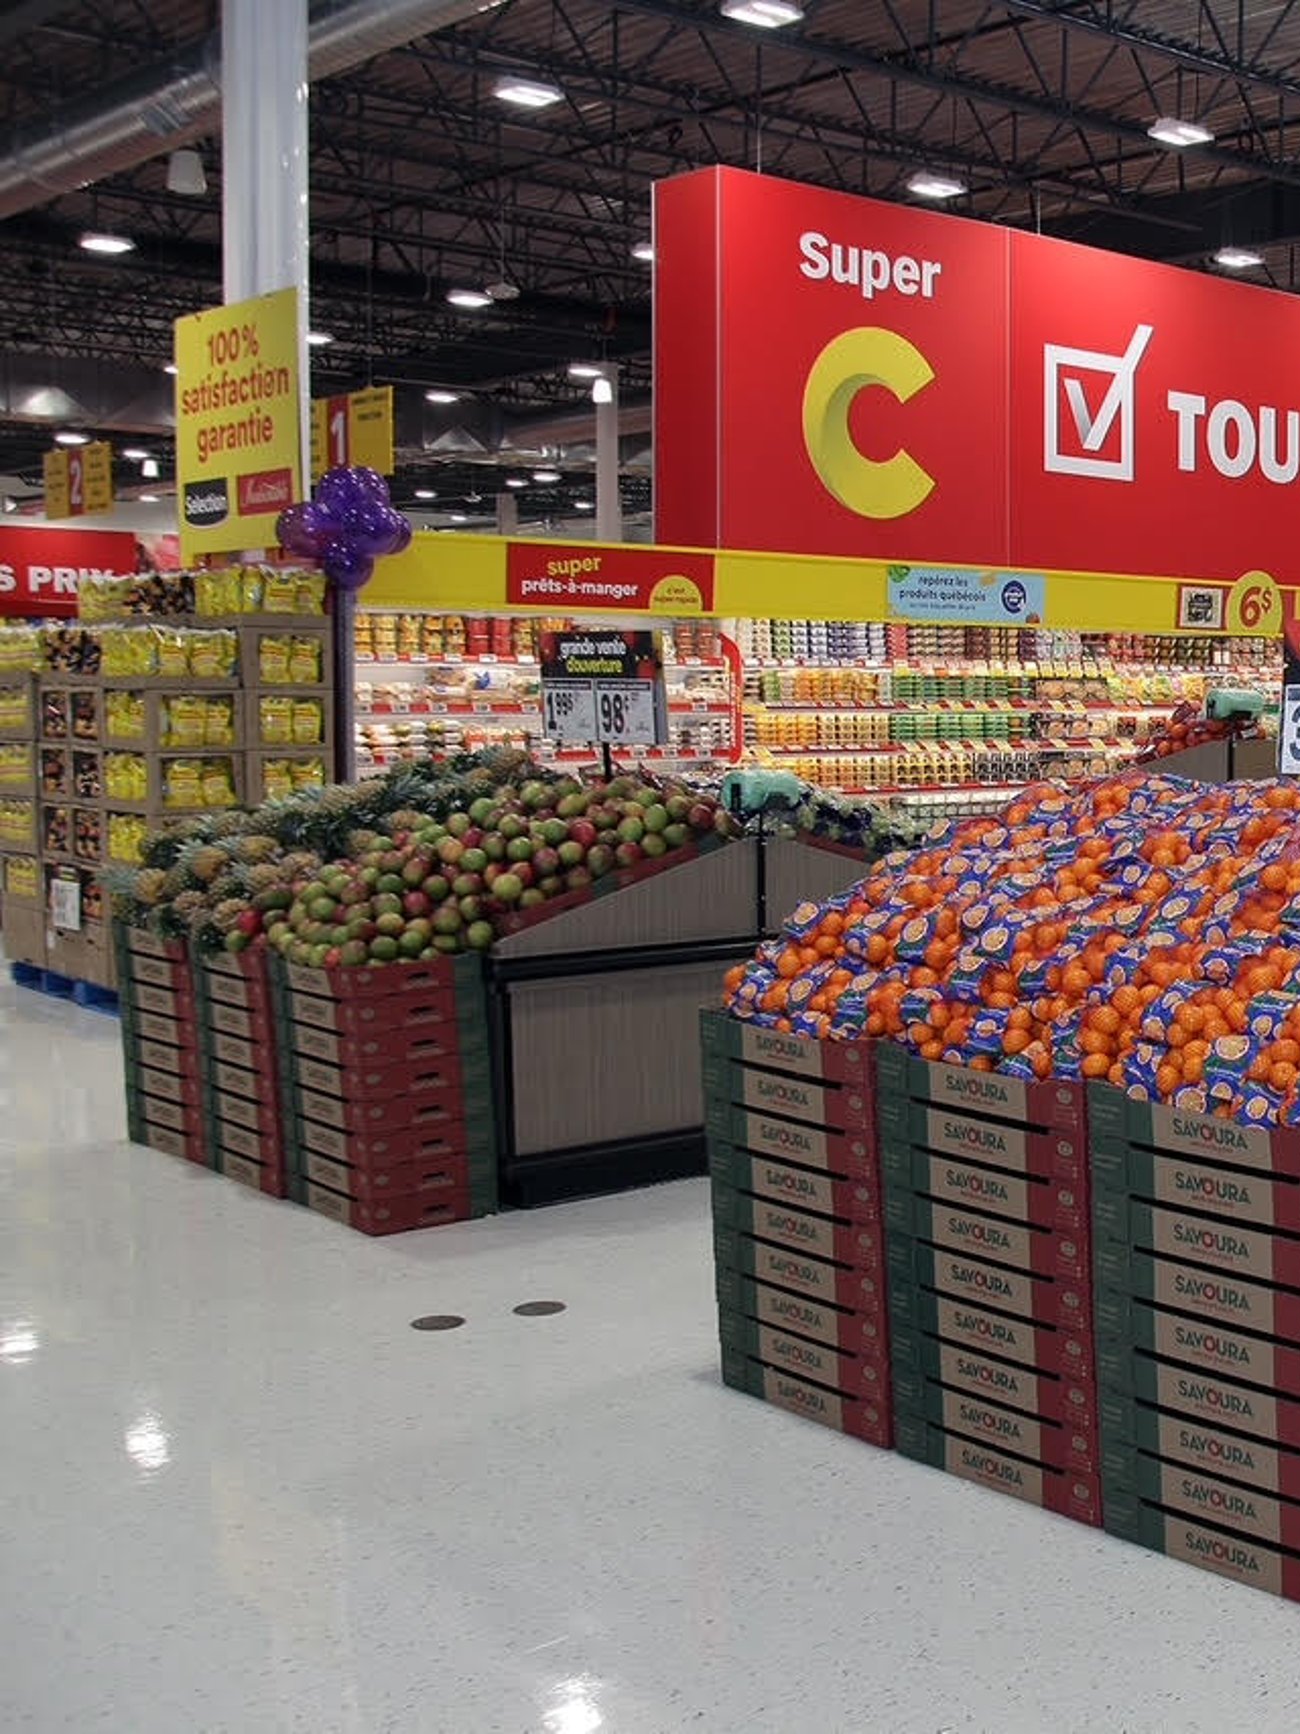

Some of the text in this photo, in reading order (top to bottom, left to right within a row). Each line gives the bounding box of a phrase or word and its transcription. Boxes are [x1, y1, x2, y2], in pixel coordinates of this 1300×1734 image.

[799, 232, 941, 298] Super
[182, 362, 290, 415] satisfaction
[197, 410, 273, 463] garantie
[330, 411, 347, 464] 1
[802, 326, 936, 519] C
[70, 458, 82, 505] 2
[547, 556, 602, 577] super
[521, 577, 639, 599] prêts-à-manger
[899, 588, 938, 600] produits
[945, 1074, 1008, 1102] SAVOURA
[944, 1123, 1007, 1151] SAVOURA
[1173, 1118, 1248, 1151] SAVOURA
[946, 1170, 1008, 1200] SAVOURA
[1175, 1171, 1251, 1204] SAVOURA
[948, 1217, 1010, 1250] SAVOURA
[1174, 1223, 1250, 1260] SAVOURA
[951, 1265, 1013, 1297] SAVOURA
[1175, 1274, 1251, 1311] SAVOURA
[954, 1312, 1015, 1345] SAVOURA
[1175, 1326, 1250, 1365] SAVOURA
[957, 1359, 1018, 1391] SAVOURA
[1178, 1379, 1253, 1417] SAVOURA
[960, 1405, 1021, 1438] SAVOURA
[962, 1450, 1023, 1486] SAVOURA
[1180, 1430, 1255, 1470] SAVOURA
[1182, 1479, 1257, 1520] SAVOURA
[1185, 1532, 1260, 1574] SAVOURA
